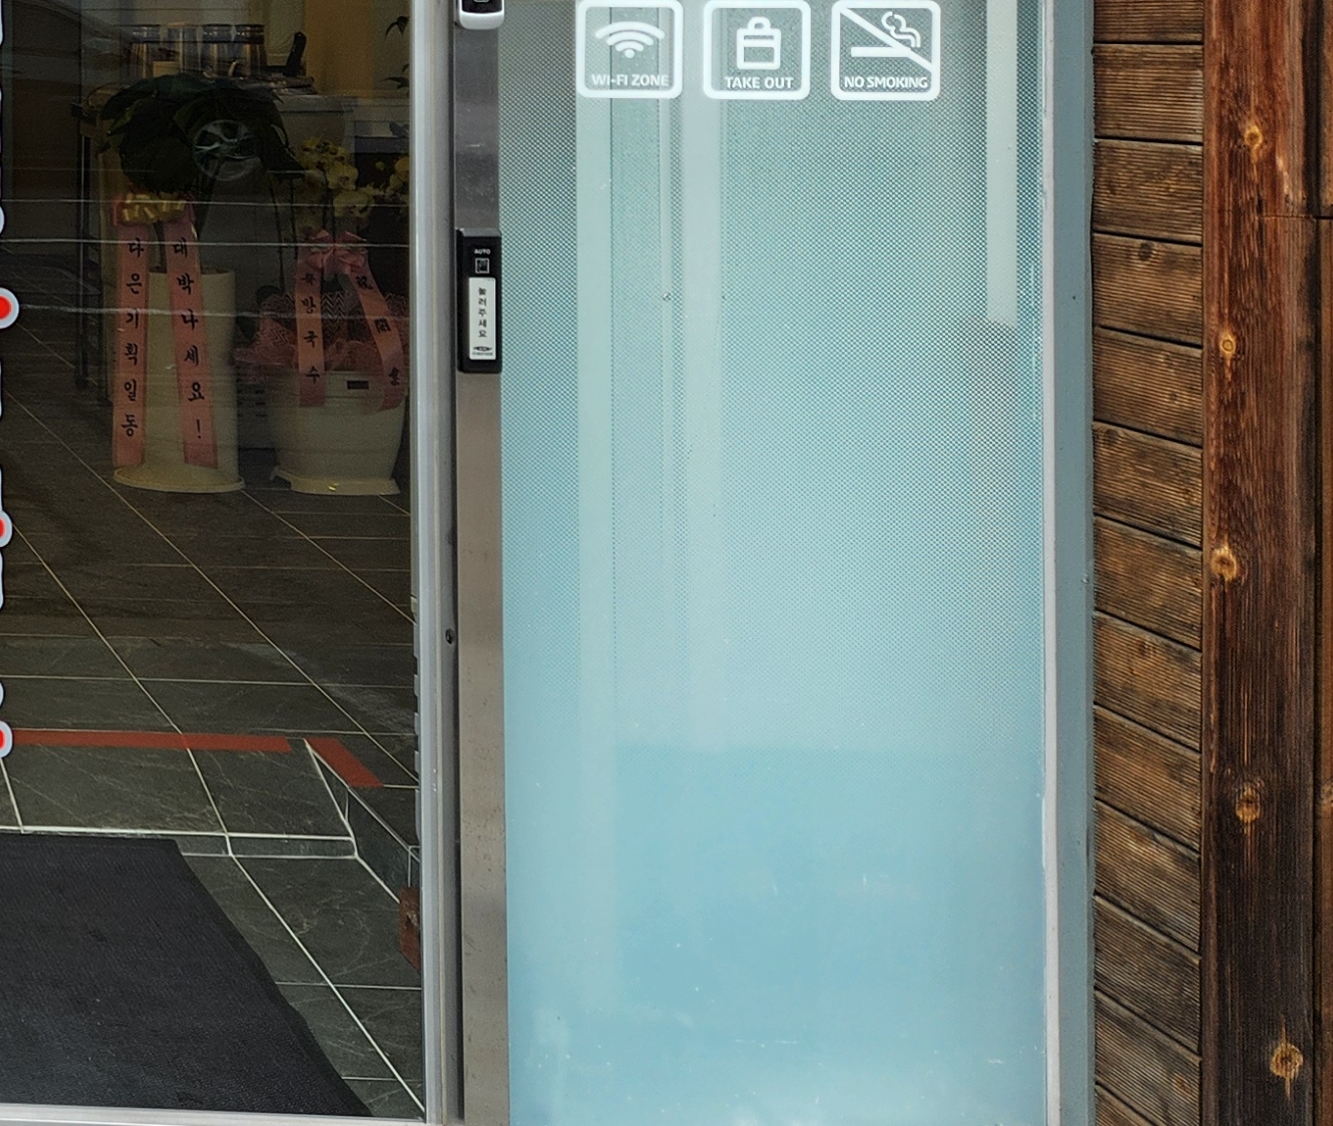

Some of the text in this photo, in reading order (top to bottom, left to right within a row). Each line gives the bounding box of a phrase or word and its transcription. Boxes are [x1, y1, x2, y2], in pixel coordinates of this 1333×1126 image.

[591, 74, 669, 86] WI-FI ZONE
[725, 77, 793, 89] TAKE OUT
[844, 76, 928, 88] NO SMOKING
[477, 286, 488, 339] 눌러주세요
[172, 237, 206, 440] 대박나세요!
